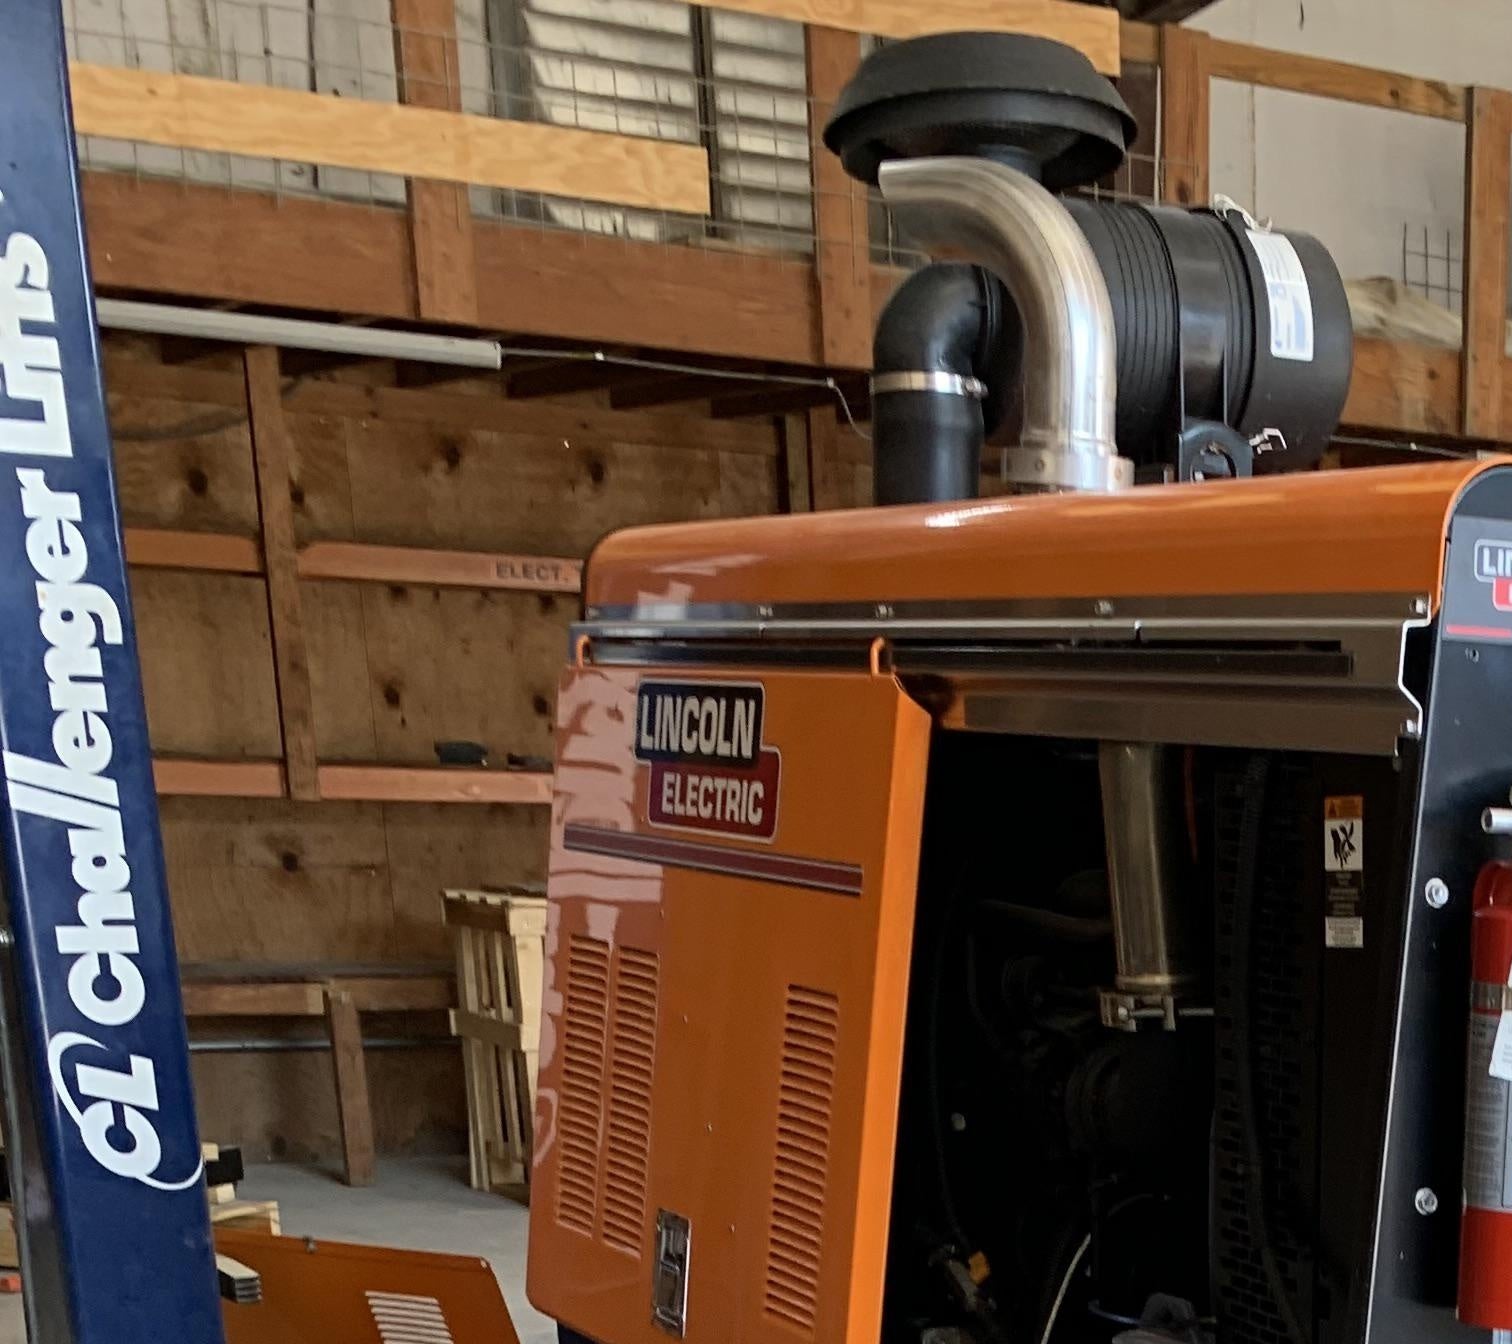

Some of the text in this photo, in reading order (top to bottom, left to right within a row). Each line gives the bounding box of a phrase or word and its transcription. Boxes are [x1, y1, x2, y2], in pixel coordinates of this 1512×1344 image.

[3, 467, 146, 1026] Challenger
[641, 695, 756, 759] LINCOLN
[661, 772, 765, 826] ELECTRIC
